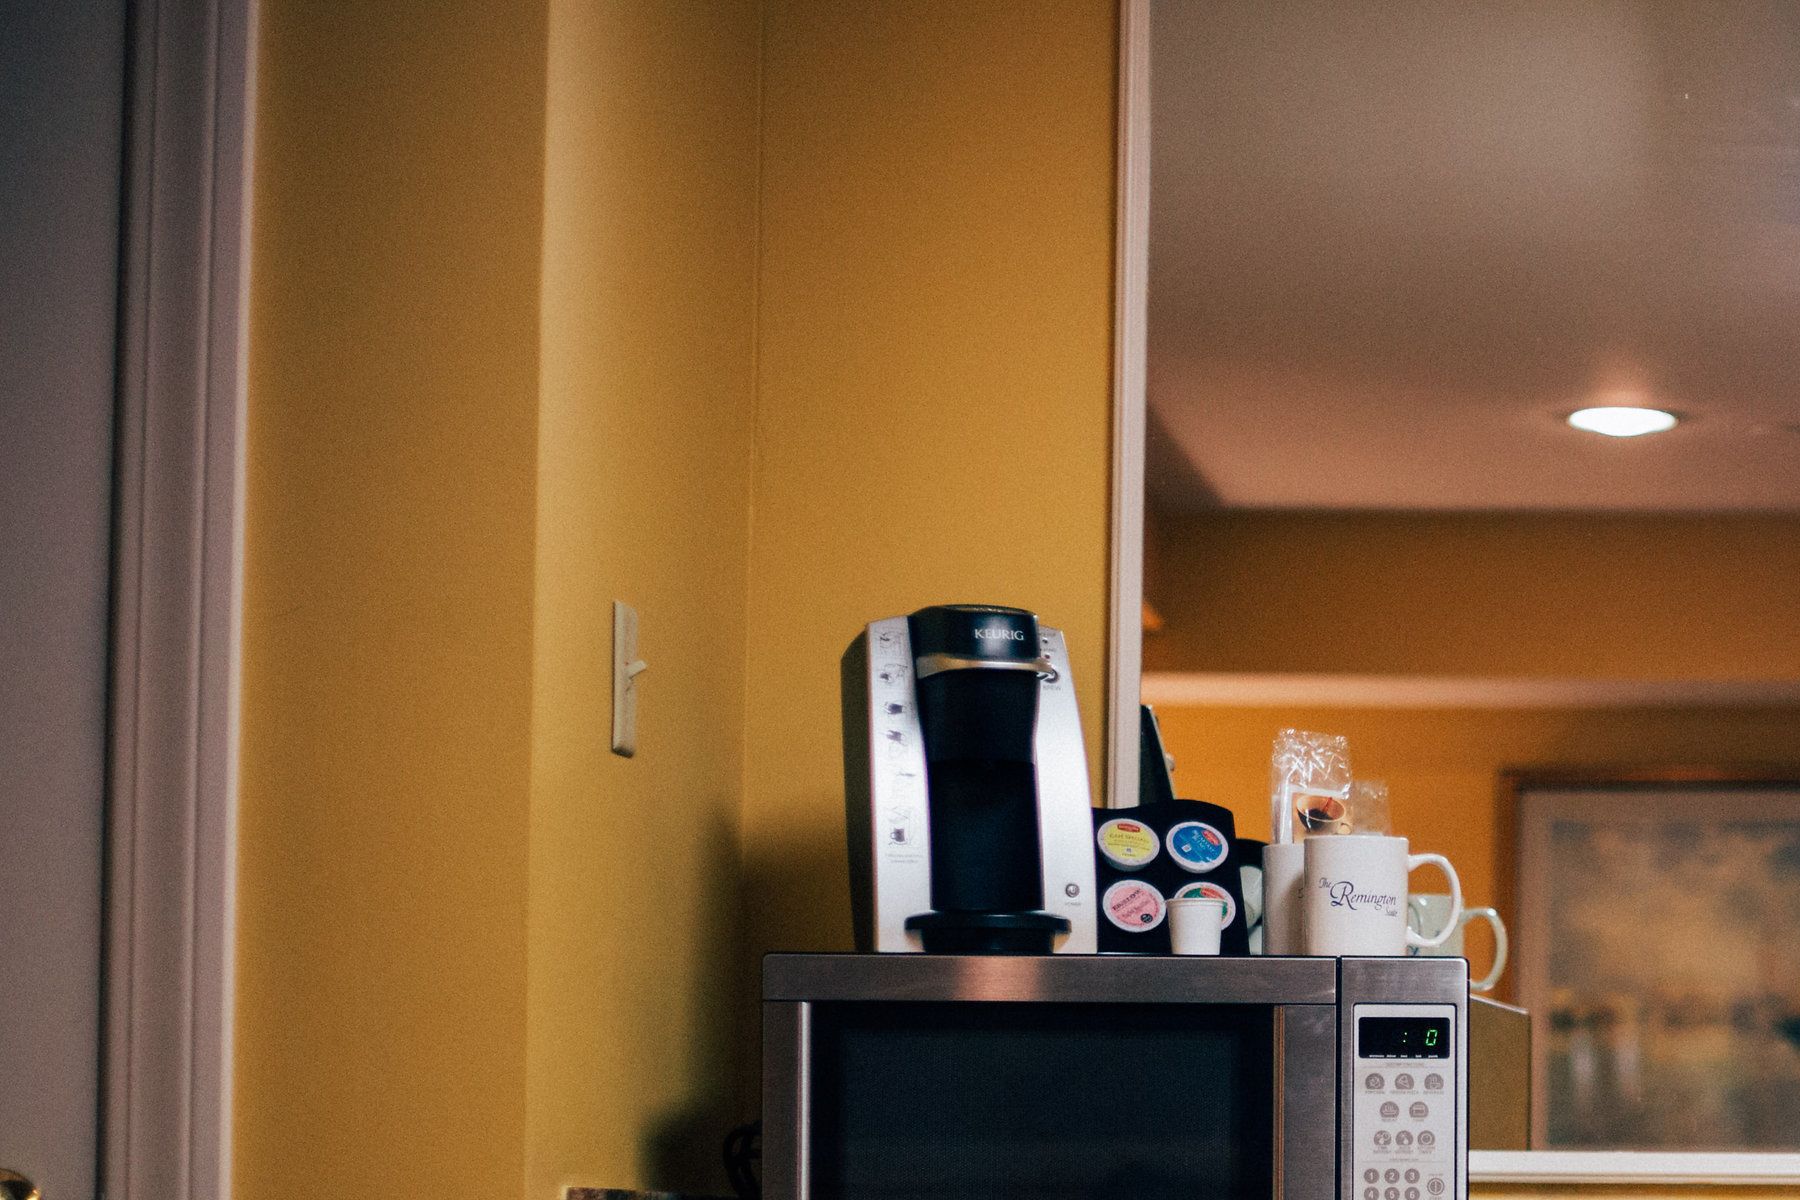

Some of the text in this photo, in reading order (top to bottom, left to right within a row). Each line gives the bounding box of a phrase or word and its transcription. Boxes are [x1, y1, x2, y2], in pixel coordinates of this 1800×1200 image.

[974, 628, 1025, 641] KEURIG
[1318, 877, 1332, 889] The
[1329, 881, 1397, 911] Remington
[1369, 1172, 1415, 1180] 1 2 3
[1369, 1190, 1374, 1199] 4
[1409, 1190, 1415, 1199] 6
